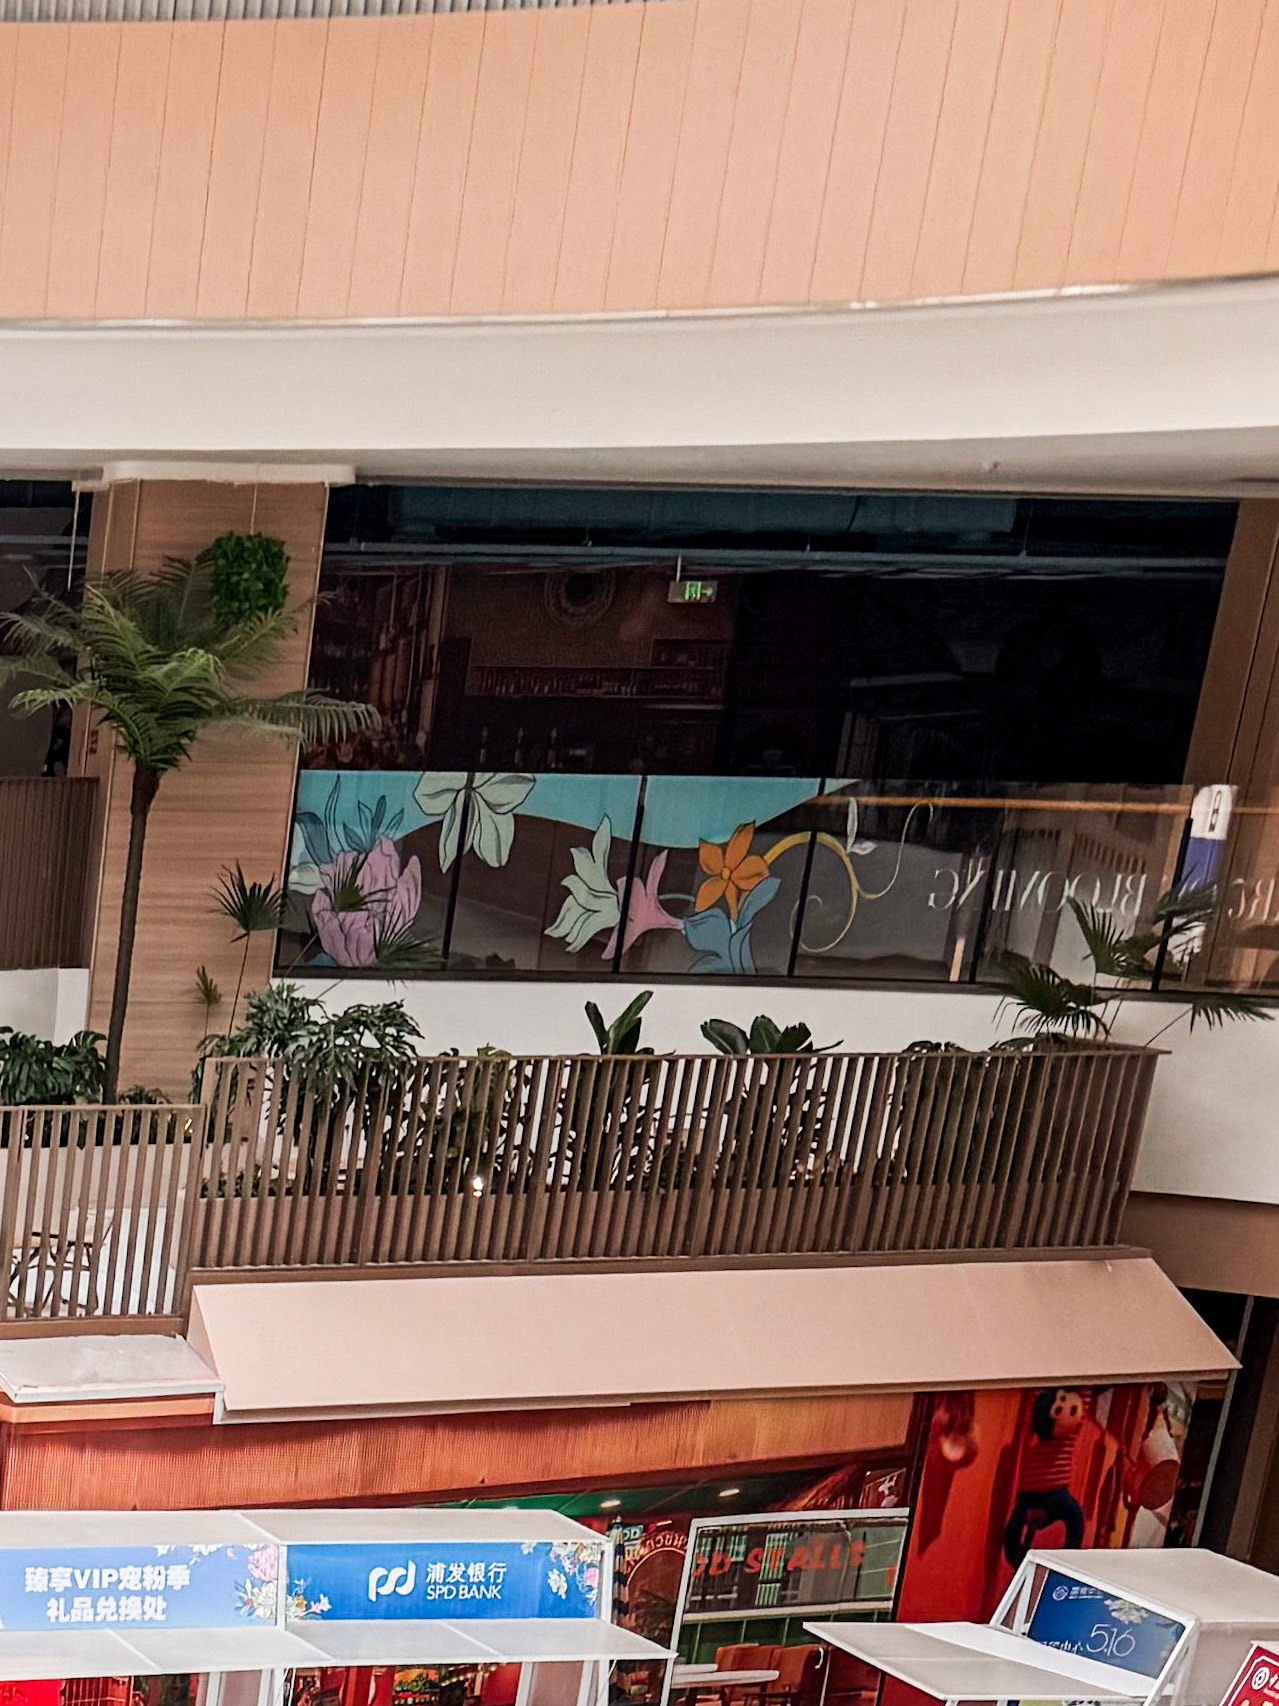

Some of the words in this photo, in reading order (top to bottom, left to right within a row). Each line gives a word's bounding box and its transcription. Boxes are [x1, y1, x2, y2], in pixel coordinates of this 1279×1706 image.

[425, 1562, 507, 1584] 浦发银行
[458, 1584, 502, 1600] BANK
[46, 1597, 168, 1623] 礼品兑换处
